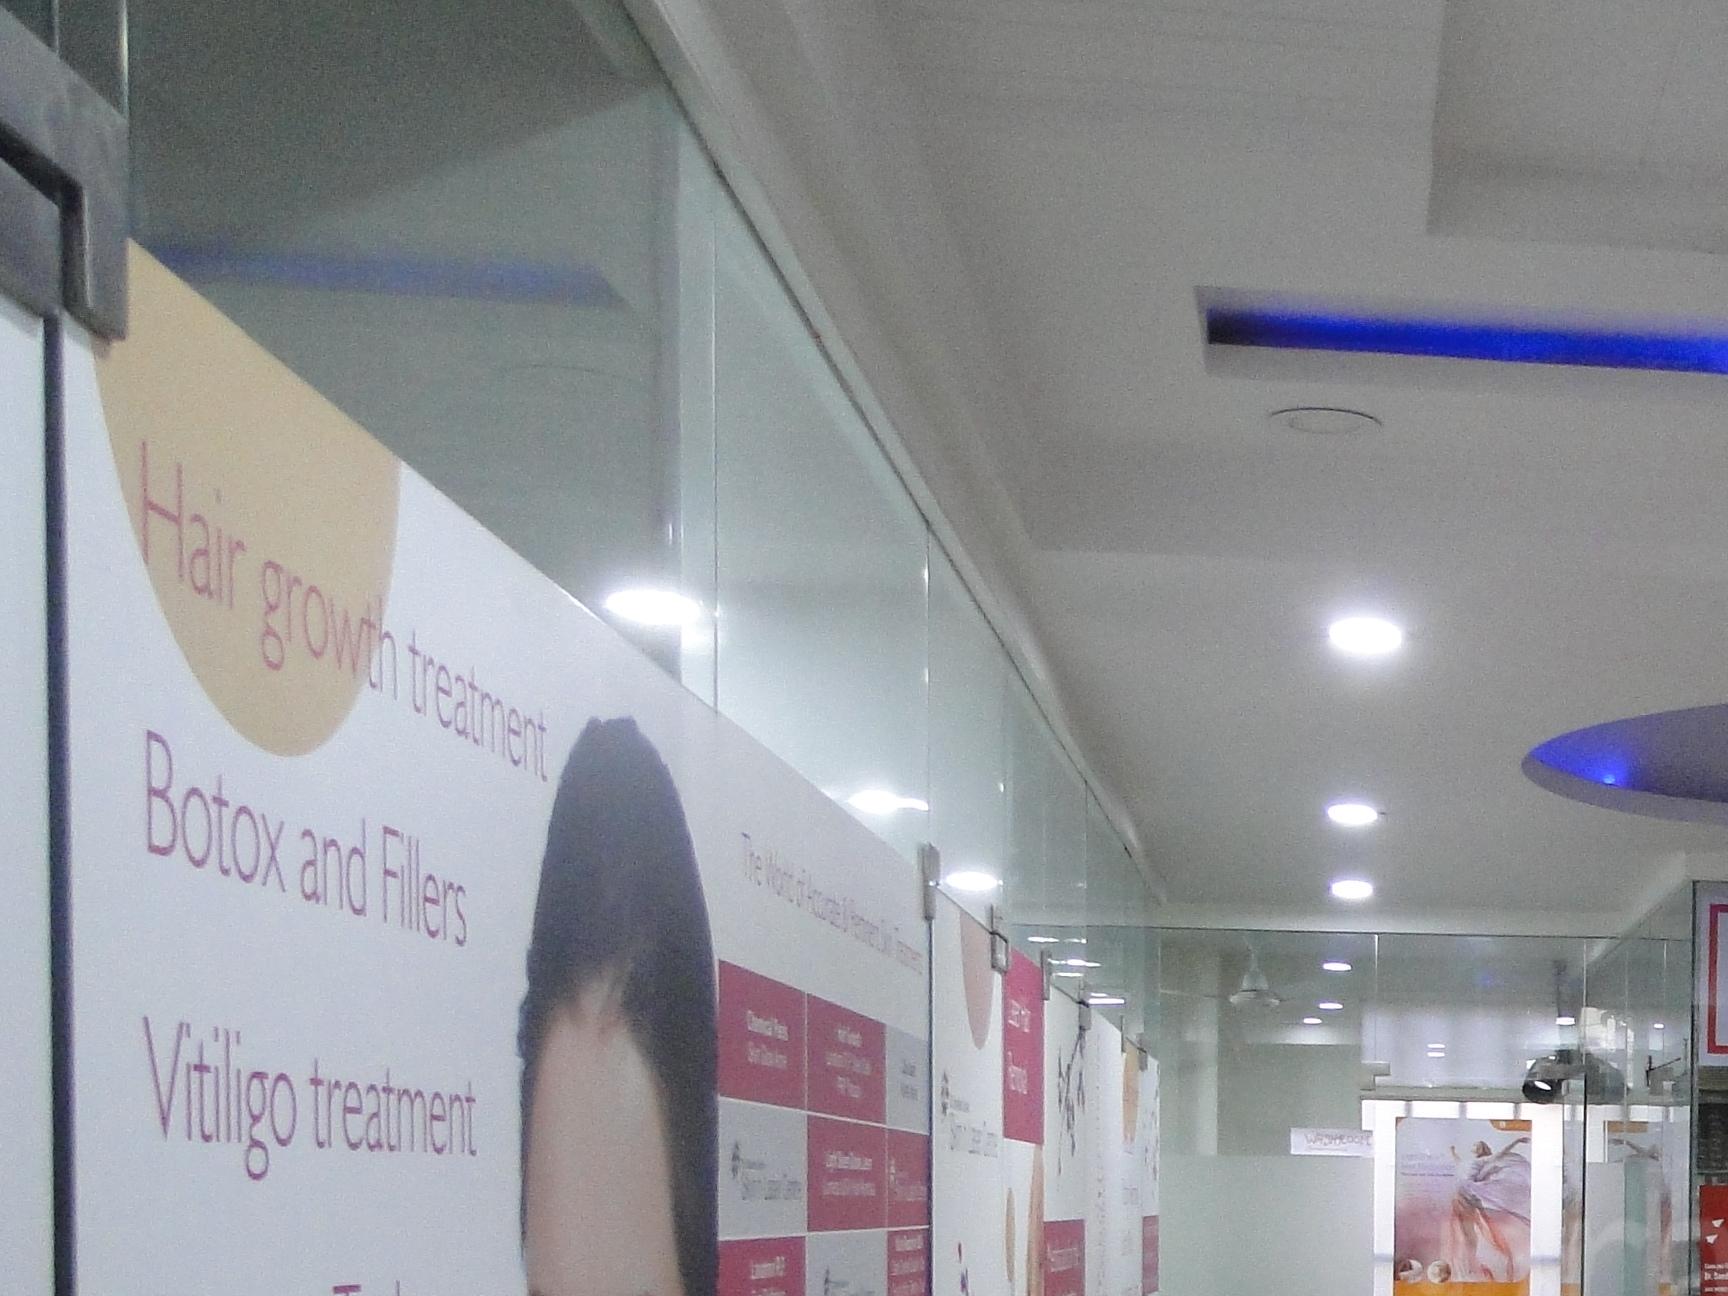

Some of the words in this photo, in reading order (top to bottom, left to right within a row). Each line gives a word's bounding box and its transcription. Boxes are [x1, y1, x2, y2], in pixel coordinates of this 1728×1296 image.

[140, 440, 246, 610] Hair
[260, 558, 398, 701] growth
[408, 630, 549, 783] treatment
[146, 729, 286, 893] Botox
[300, 817, 367, 917] and
[142, 1015, 298, 1181] Vitiligo
[310, 1058, 478, 1157] treatment
